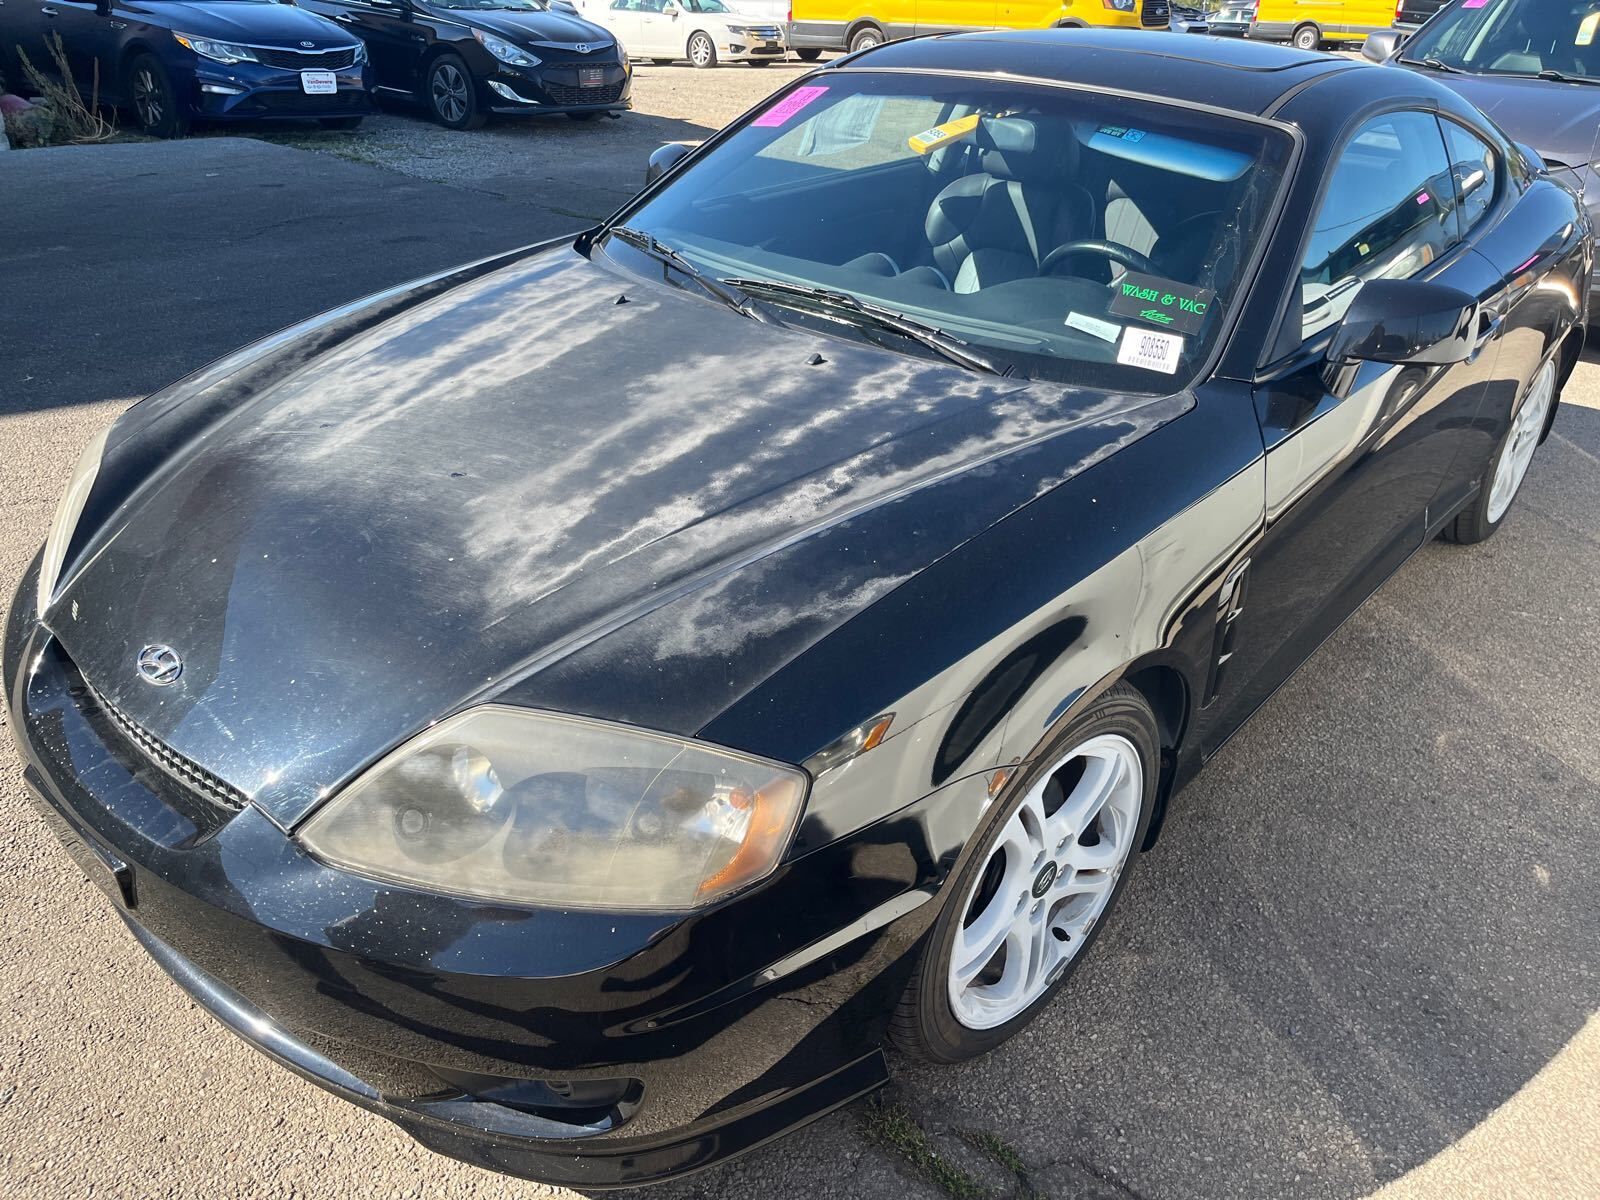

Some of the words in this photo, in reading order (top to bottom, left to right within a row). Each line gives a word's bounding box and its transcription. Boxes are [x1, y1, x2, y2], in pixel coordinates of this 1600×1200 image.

[1122, 283, 1159, 302] WASH
[1161, 294, 1176, 306] &
[1179, 297, 1206, 315] VAC
[1138, 335, 1170, 361] 908550
